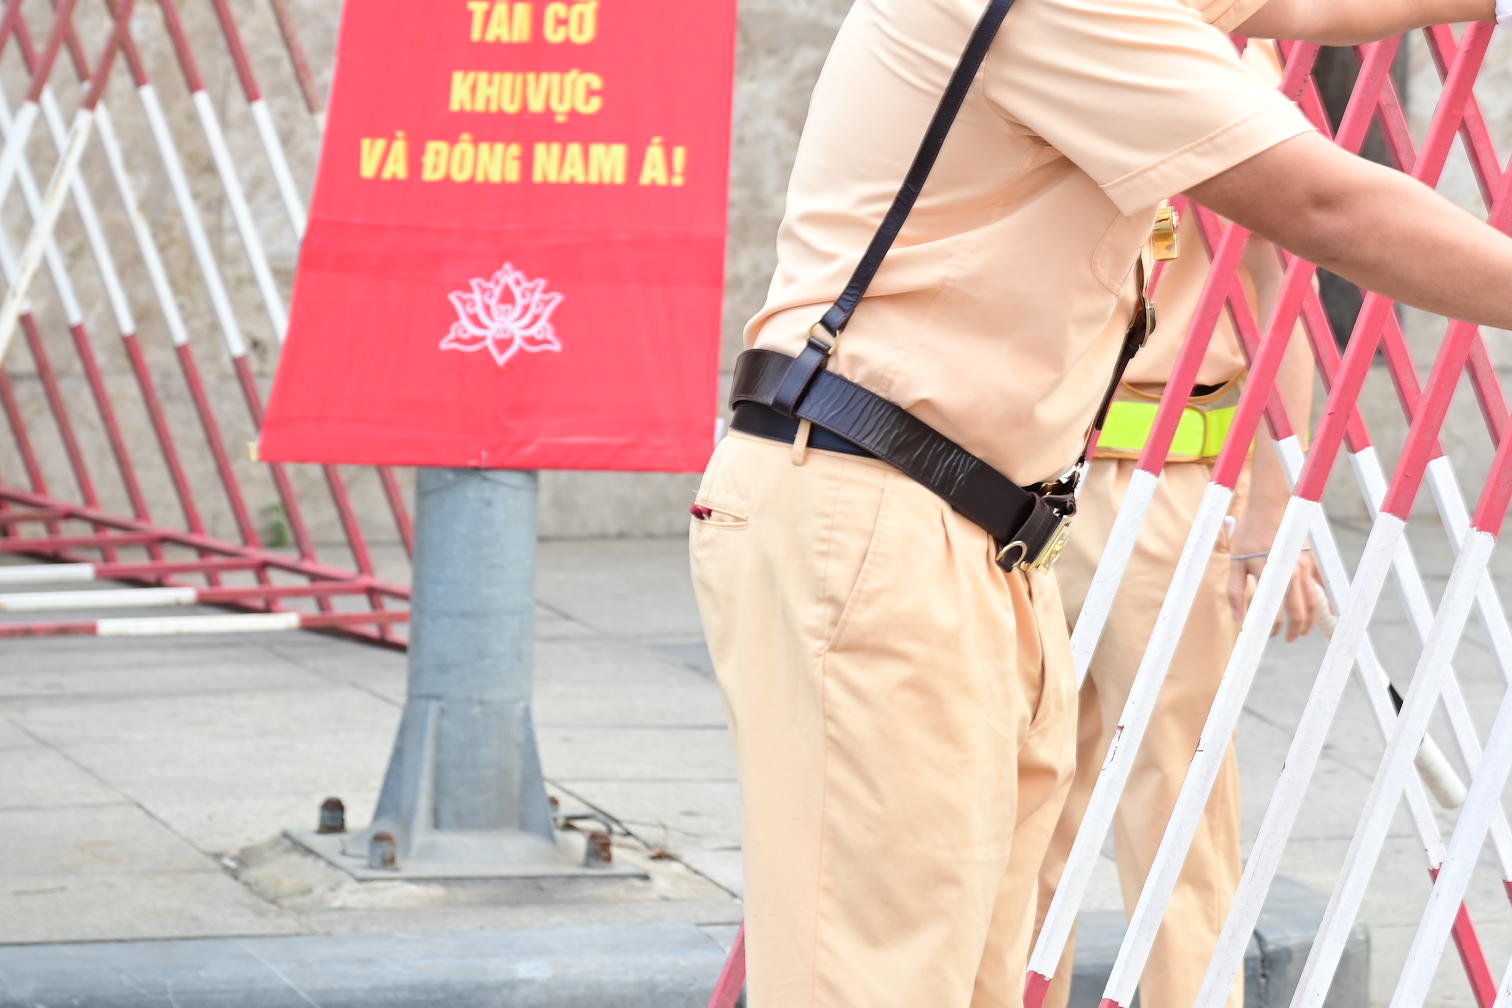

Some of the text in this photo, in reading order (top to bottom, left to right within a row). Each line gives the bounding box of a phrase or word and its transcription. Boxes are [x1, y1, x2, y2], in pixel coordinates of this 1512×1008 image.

[449, 67, 604, 123] KHU VỰC
[359, 130, 408, 181] VÀ
[421, 131, 522, 184] ĐÔNG
[531, 141, 628, 186] NAM
